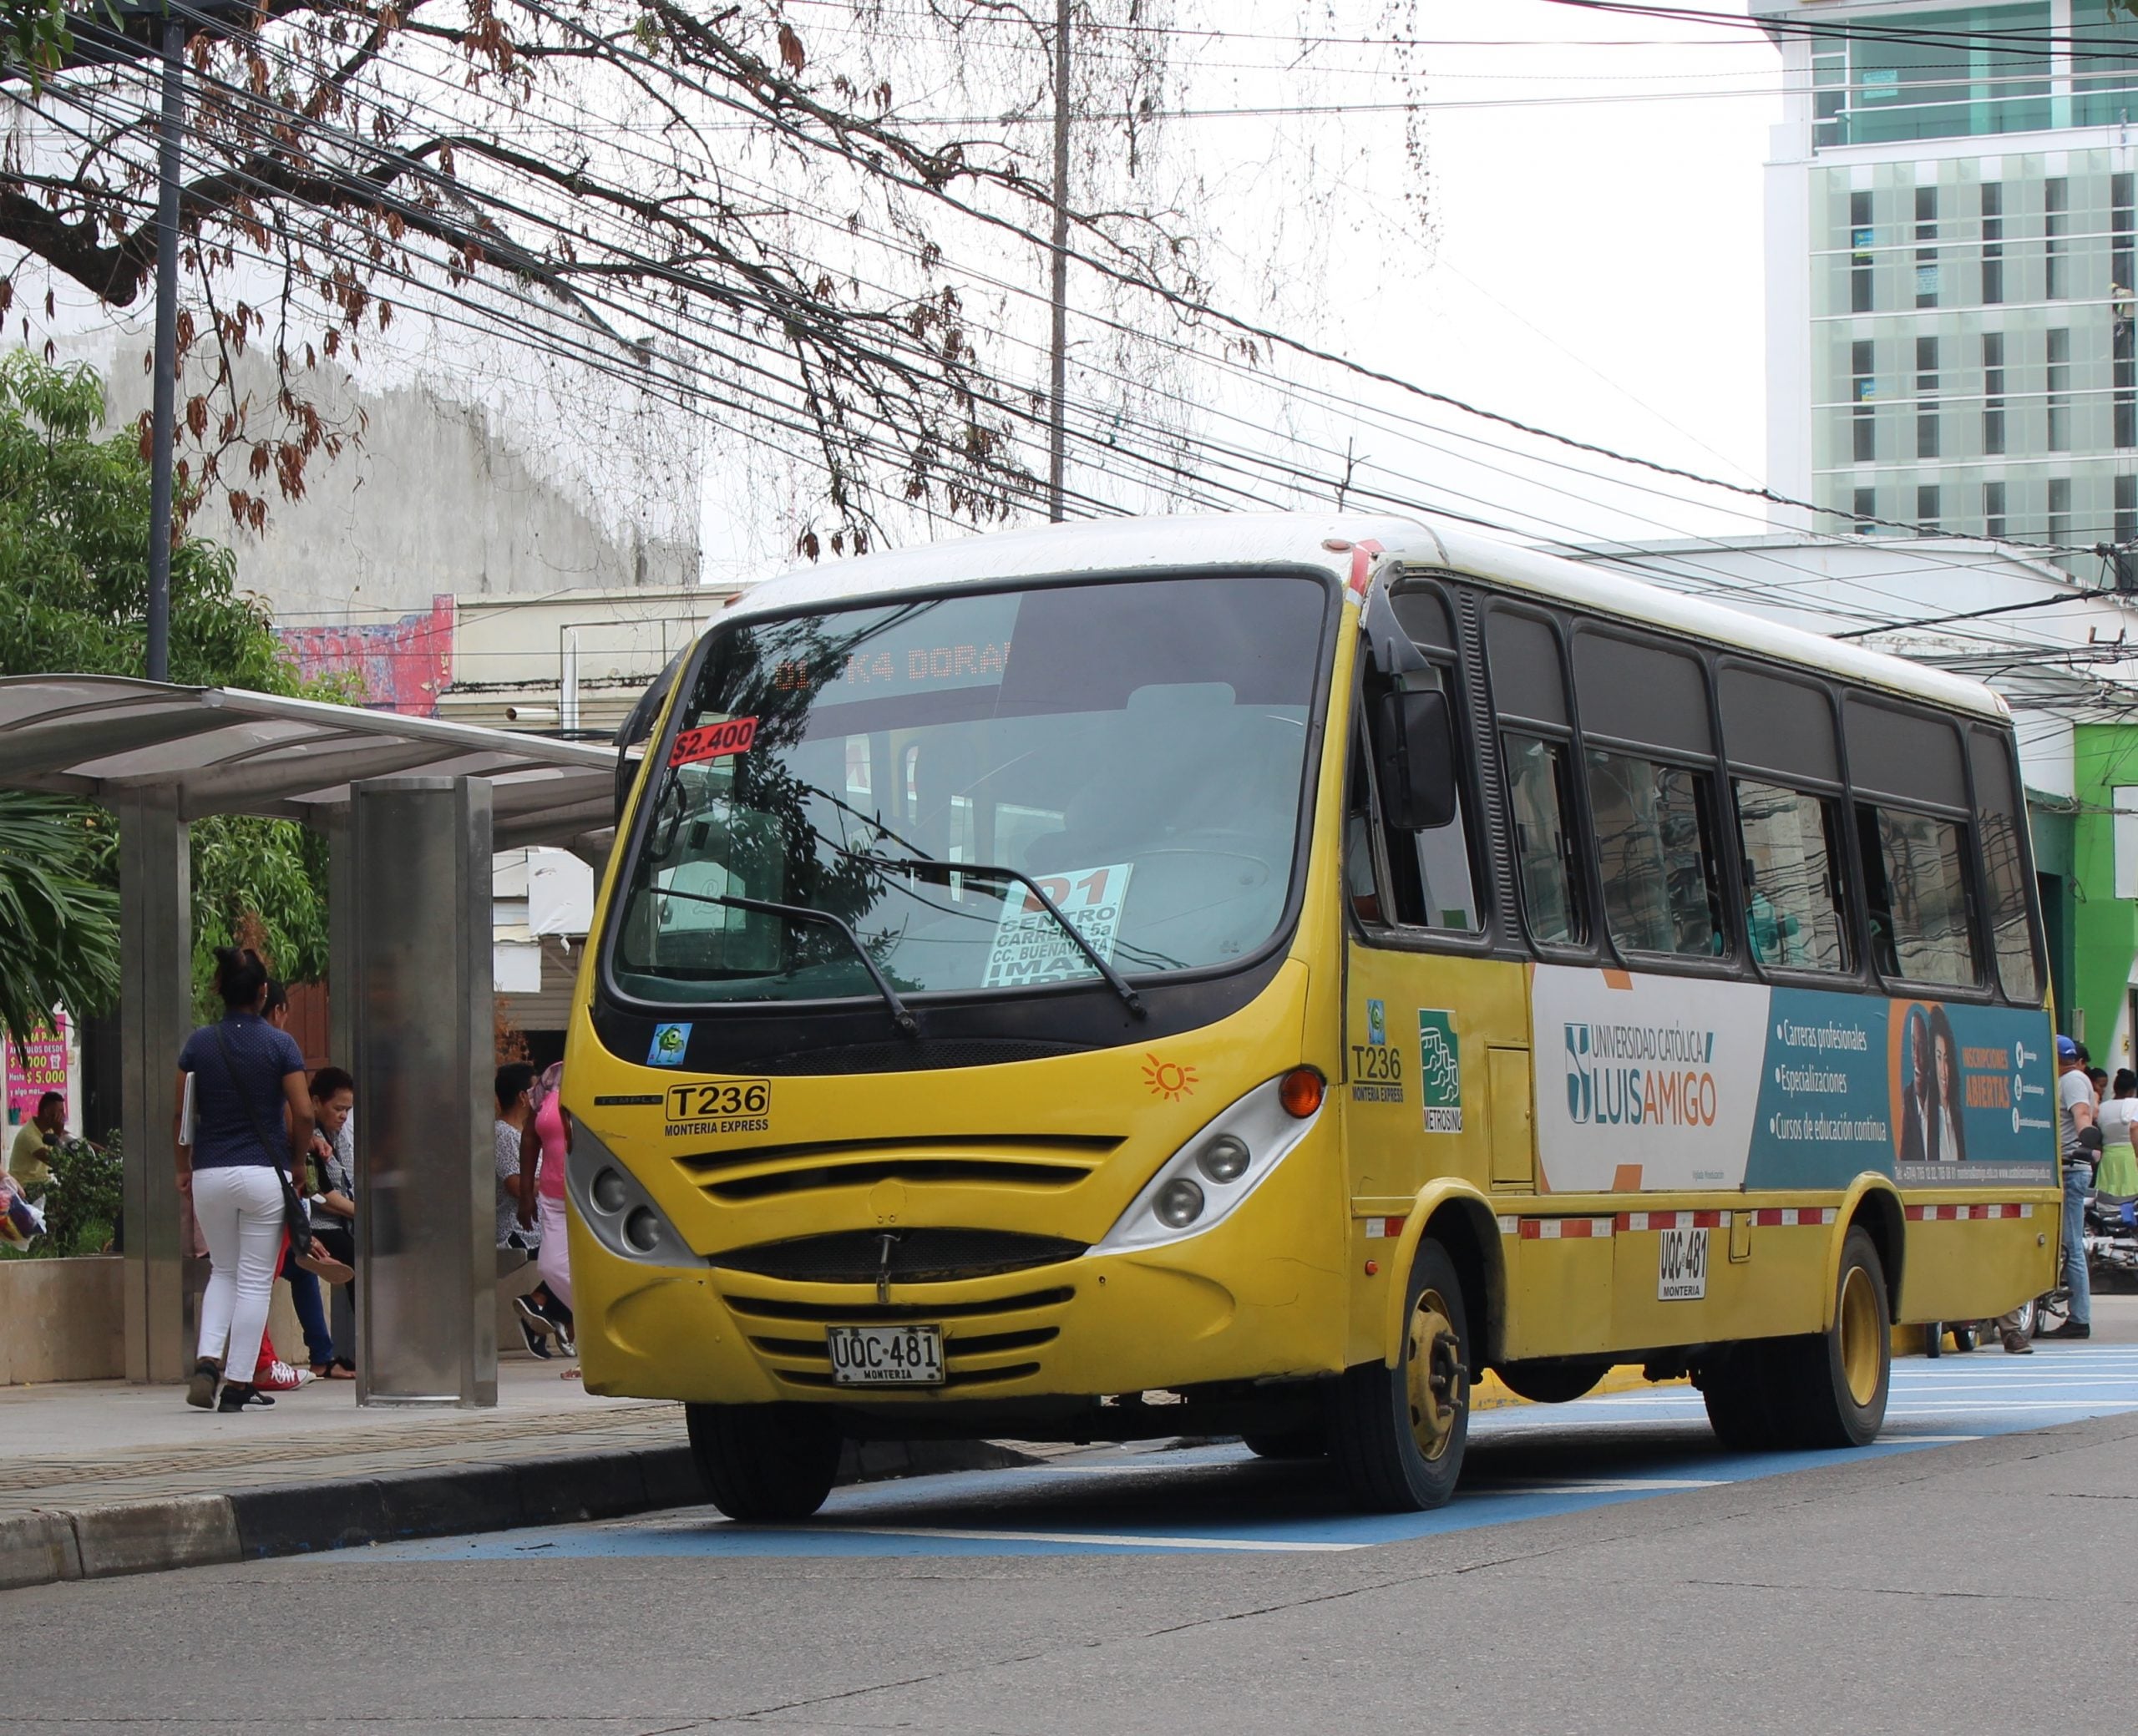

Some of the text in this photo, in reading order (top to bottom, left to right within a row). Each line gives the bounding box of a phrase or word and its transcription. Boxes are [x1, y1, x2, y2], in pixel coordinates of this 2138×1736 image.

[848, 651, 894, 685] K4
[673, 722, 752, 760] $2.400
[1001, 907, 1116, 933] CENTRO
[1090, 923, 1112, 936] 5a
[992, 938, 1107, 963] CC. BUENAVITA
[1591, 1020, 1705, 1063] UNIVERSIDAD CATÓLICA
[1784, 1019, 1867, 1055] Carreras profesionales
[1352, 1045, 1401, 1079] T236
[27, 1071, 32, 1084] $
[35, 1070, 65, 1084] 5.000
[1781, 1064, 1847, 1098] Especializaciones
[1966, 1075, 2010, 1108] ABIERTAS
[671, 1086, 766, 1116] T236
[1352, 1086, 1403, 1101] MONTERIA EXPRESS
[665, 1119, 768, 1136] MONTERIA EXPRESS
[1776, 1112, 1887, 1141] Cursos de educación continua
[1663, 1285, 1700, 1296] MONTERIA
[864, 1369, 912, 1379] MONTERIA
